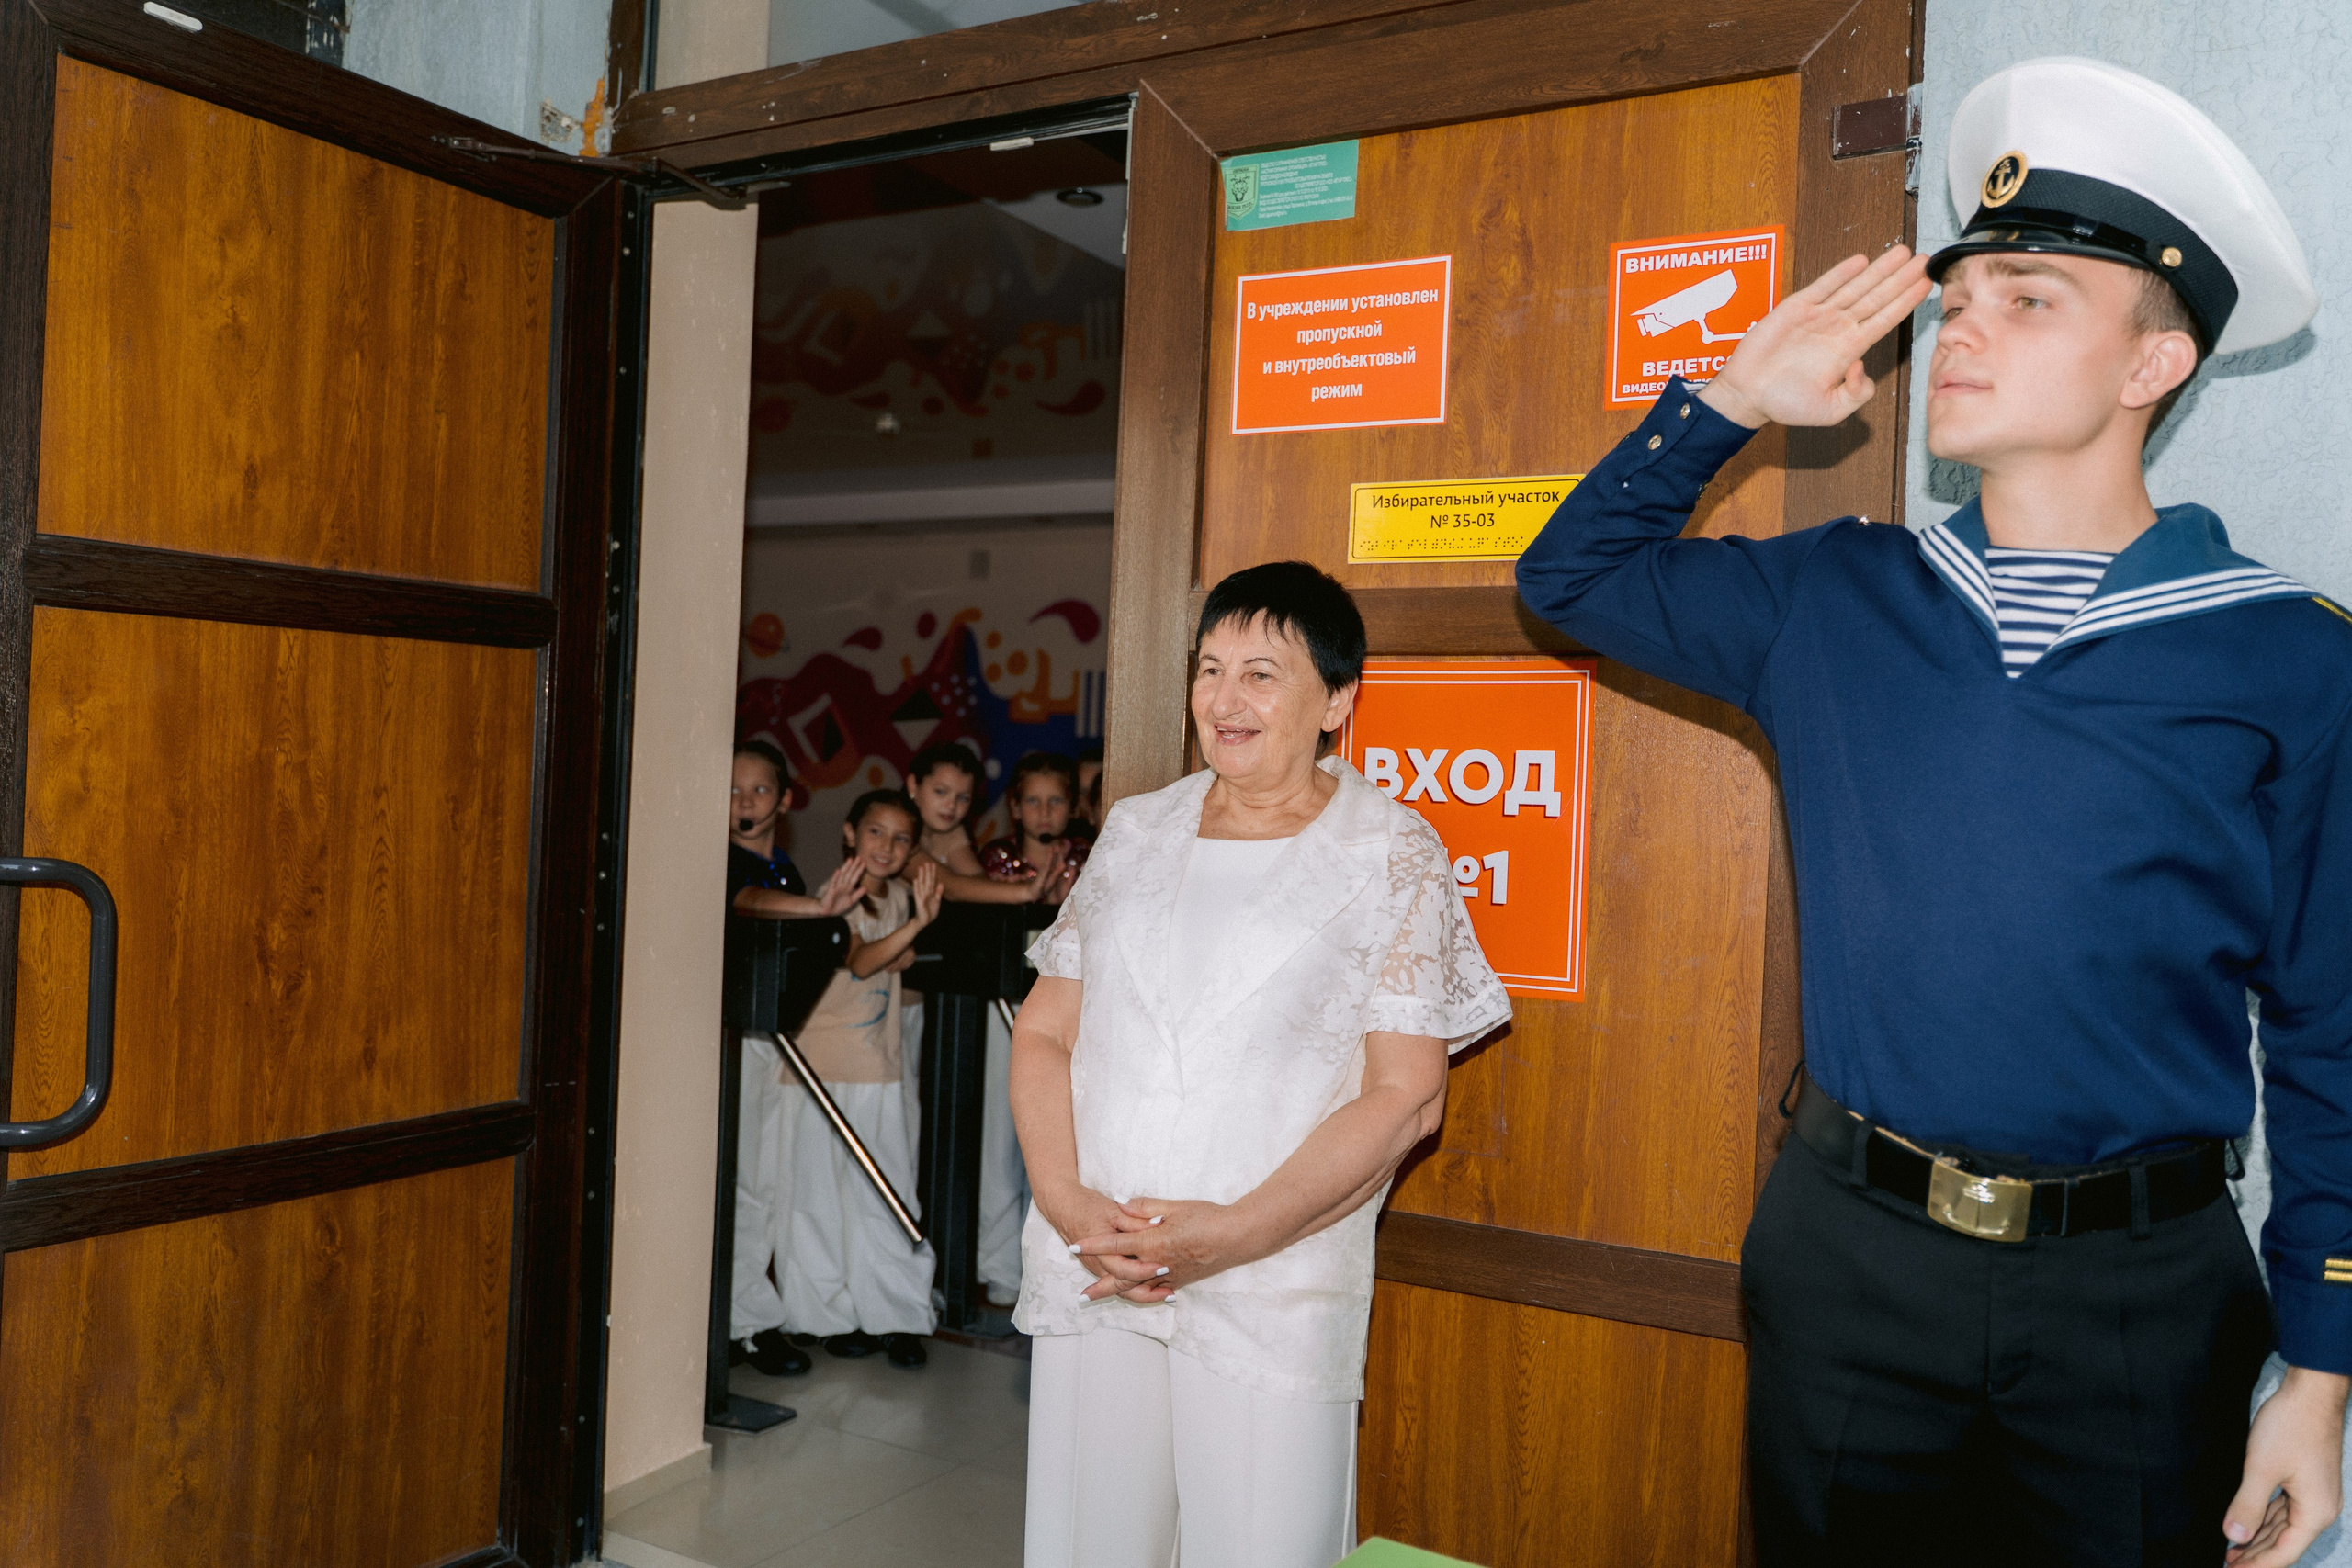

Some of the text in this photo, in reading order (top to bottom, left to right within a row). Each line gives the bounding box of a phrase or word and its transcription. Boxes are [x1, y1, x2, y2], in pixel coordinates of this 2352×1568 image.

[1625, 244, 1767, 274] ВНИМАНИЕ!!!
[1247, 288, 1439, 321] В учреждении установлен
[1296, 319, 1383, 346] пропускной
[1262, 361, 1272, 375] и
[1642, 355, 1732, 377] ВЕДЕТС
[1311, 383, 1363, 403] режим
[1373, 490, 1560, 511] Избирательный участок
[1430, 513, 1496, 529] № 35-03
[1364, 747, 1562, 818] ВХОД
